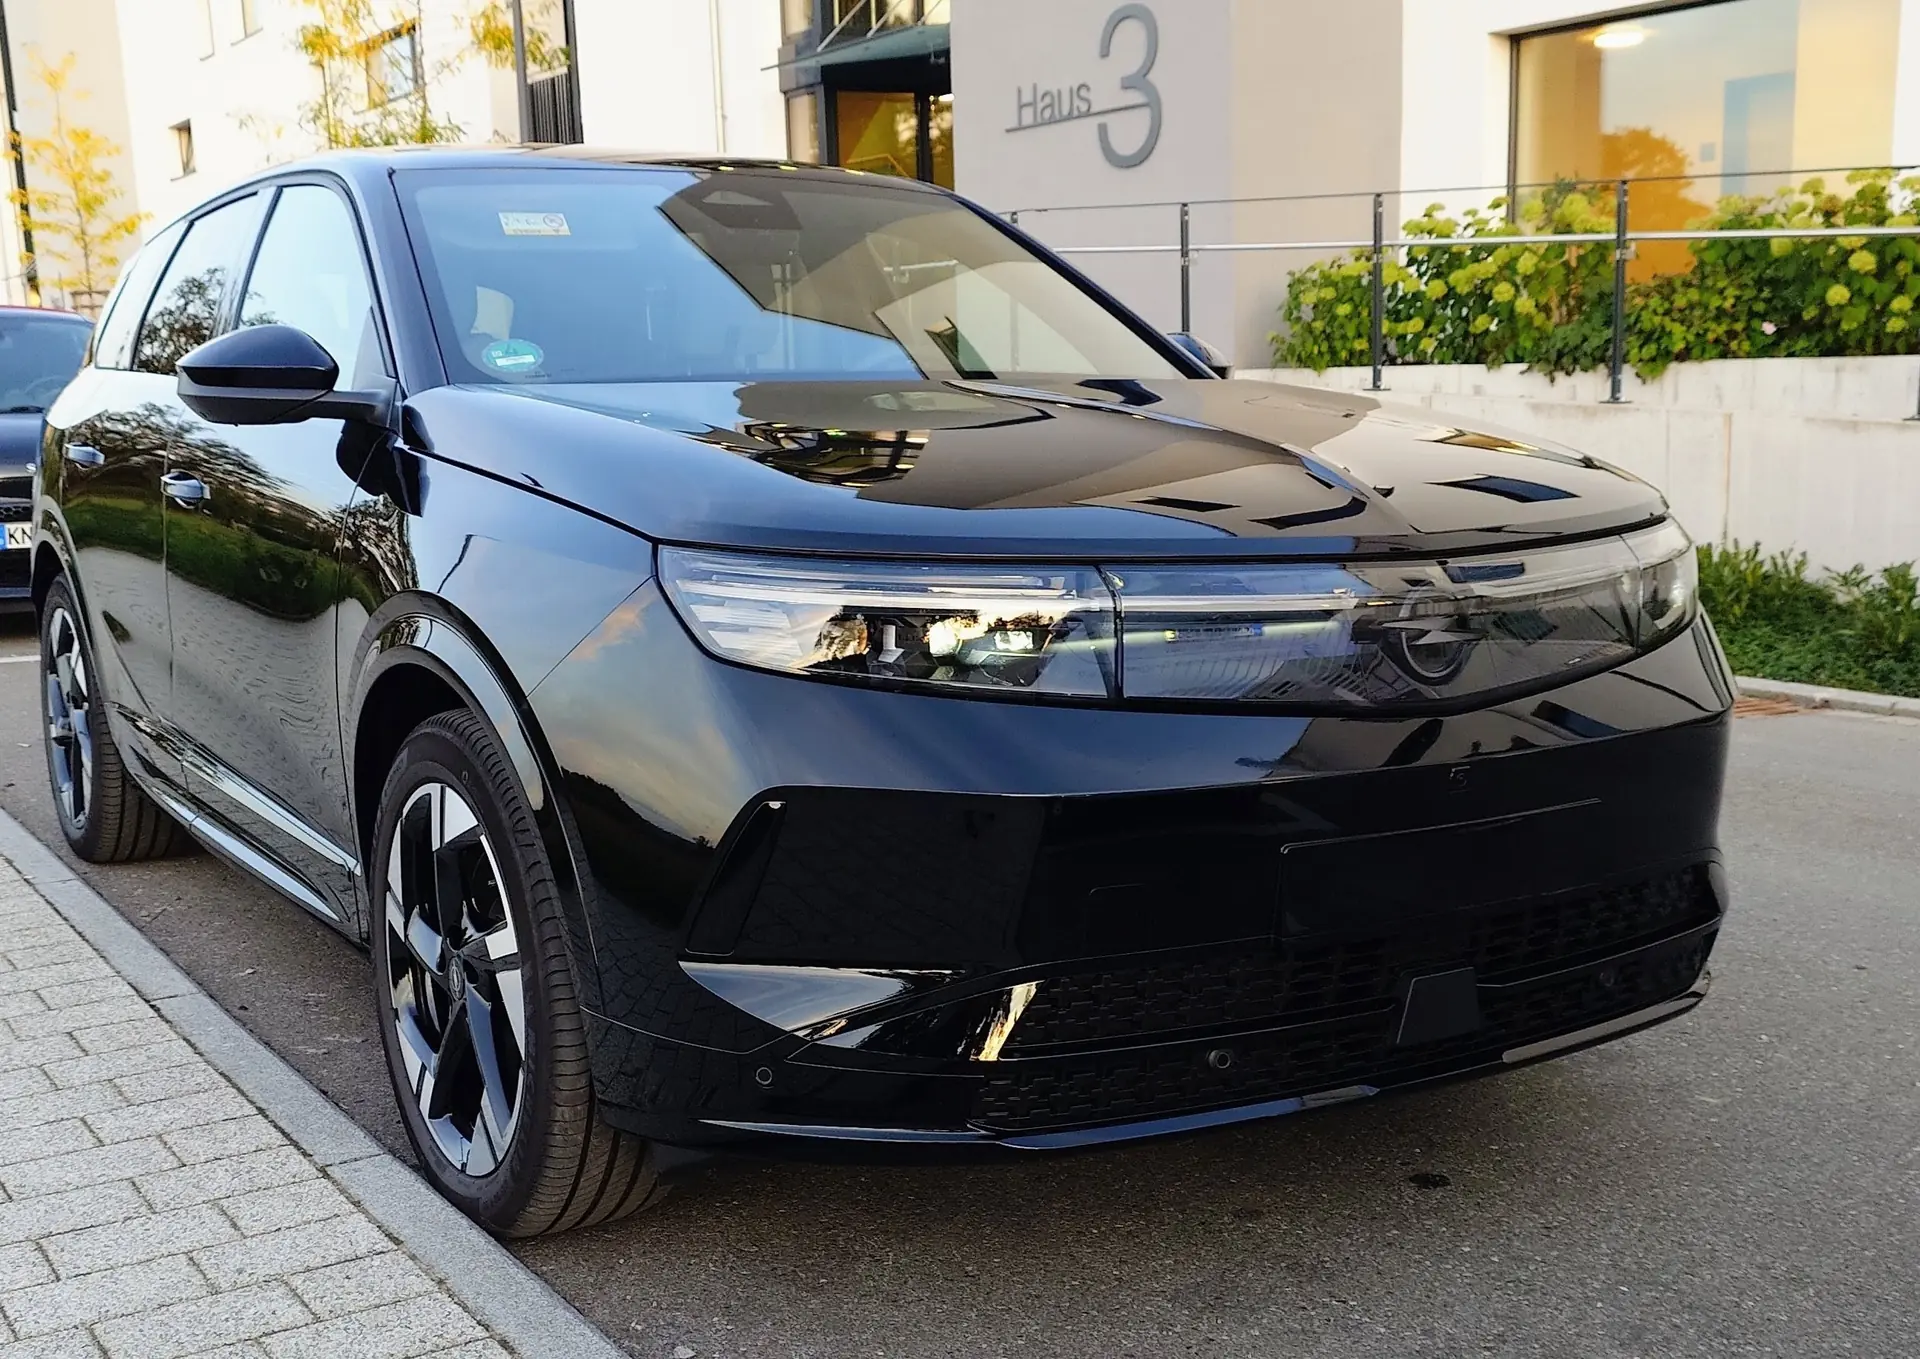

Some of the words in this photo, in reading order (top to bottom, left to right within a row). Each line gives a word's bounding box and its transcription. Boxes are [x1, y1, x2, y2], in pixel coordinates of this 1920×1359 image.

[1016, 82, 1092, 127] Haus
[1097, 3, 1162, 169] 3
[8, 527, 32, 545] KN
